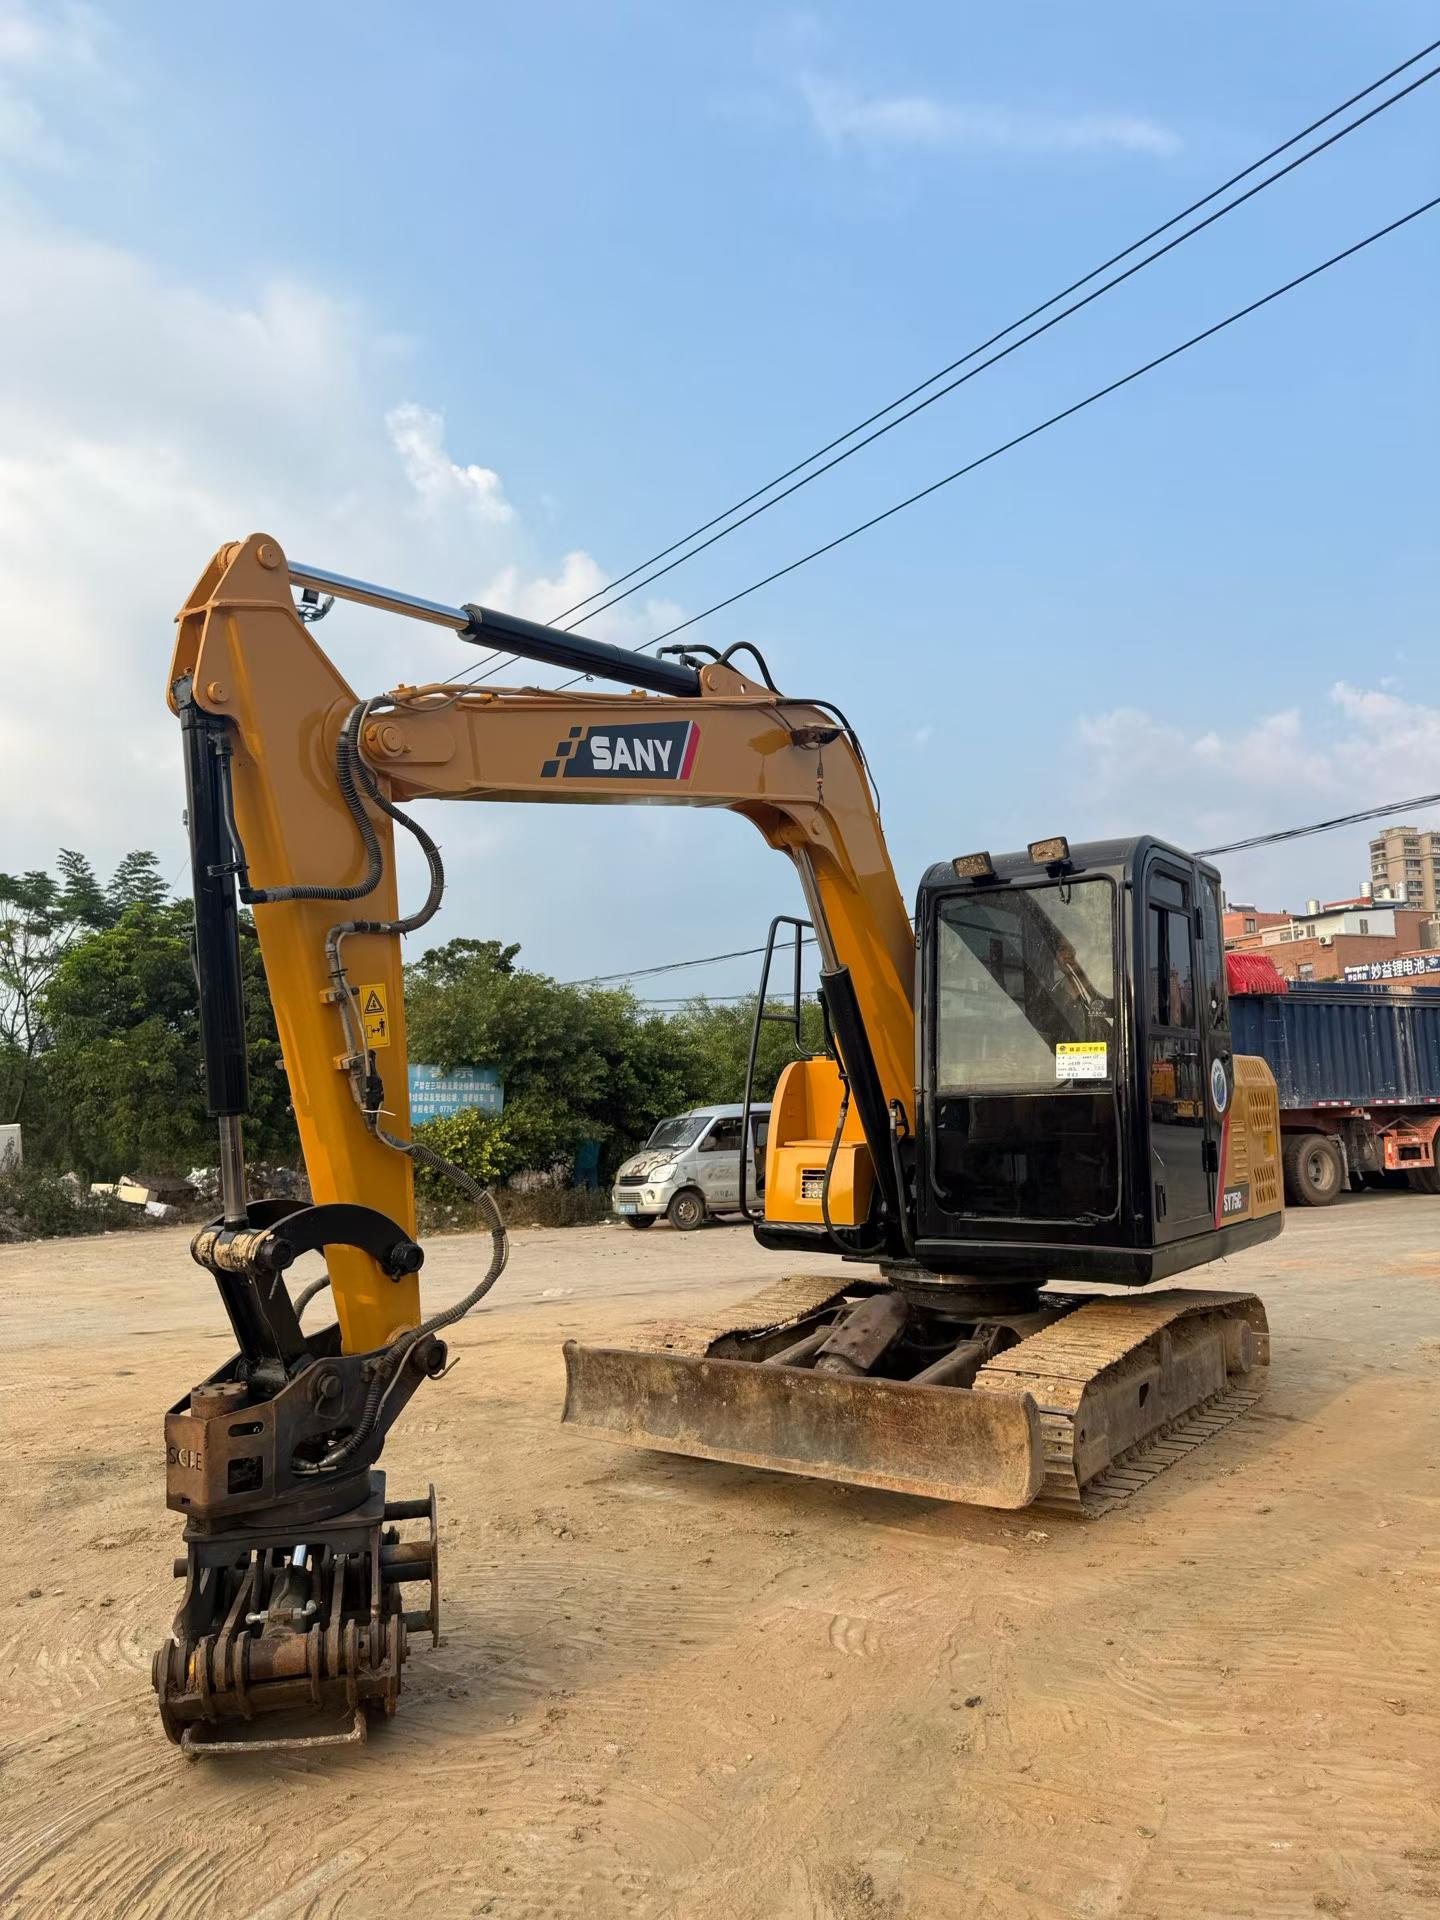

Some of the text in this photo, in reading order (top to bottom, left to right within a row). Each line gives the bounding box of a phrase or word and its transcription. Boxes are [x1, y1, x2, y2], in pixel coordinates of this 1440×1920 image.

[591, 736, 673, 772] SANY
[1371, 957, 1425, 980] 妙益锂电池
